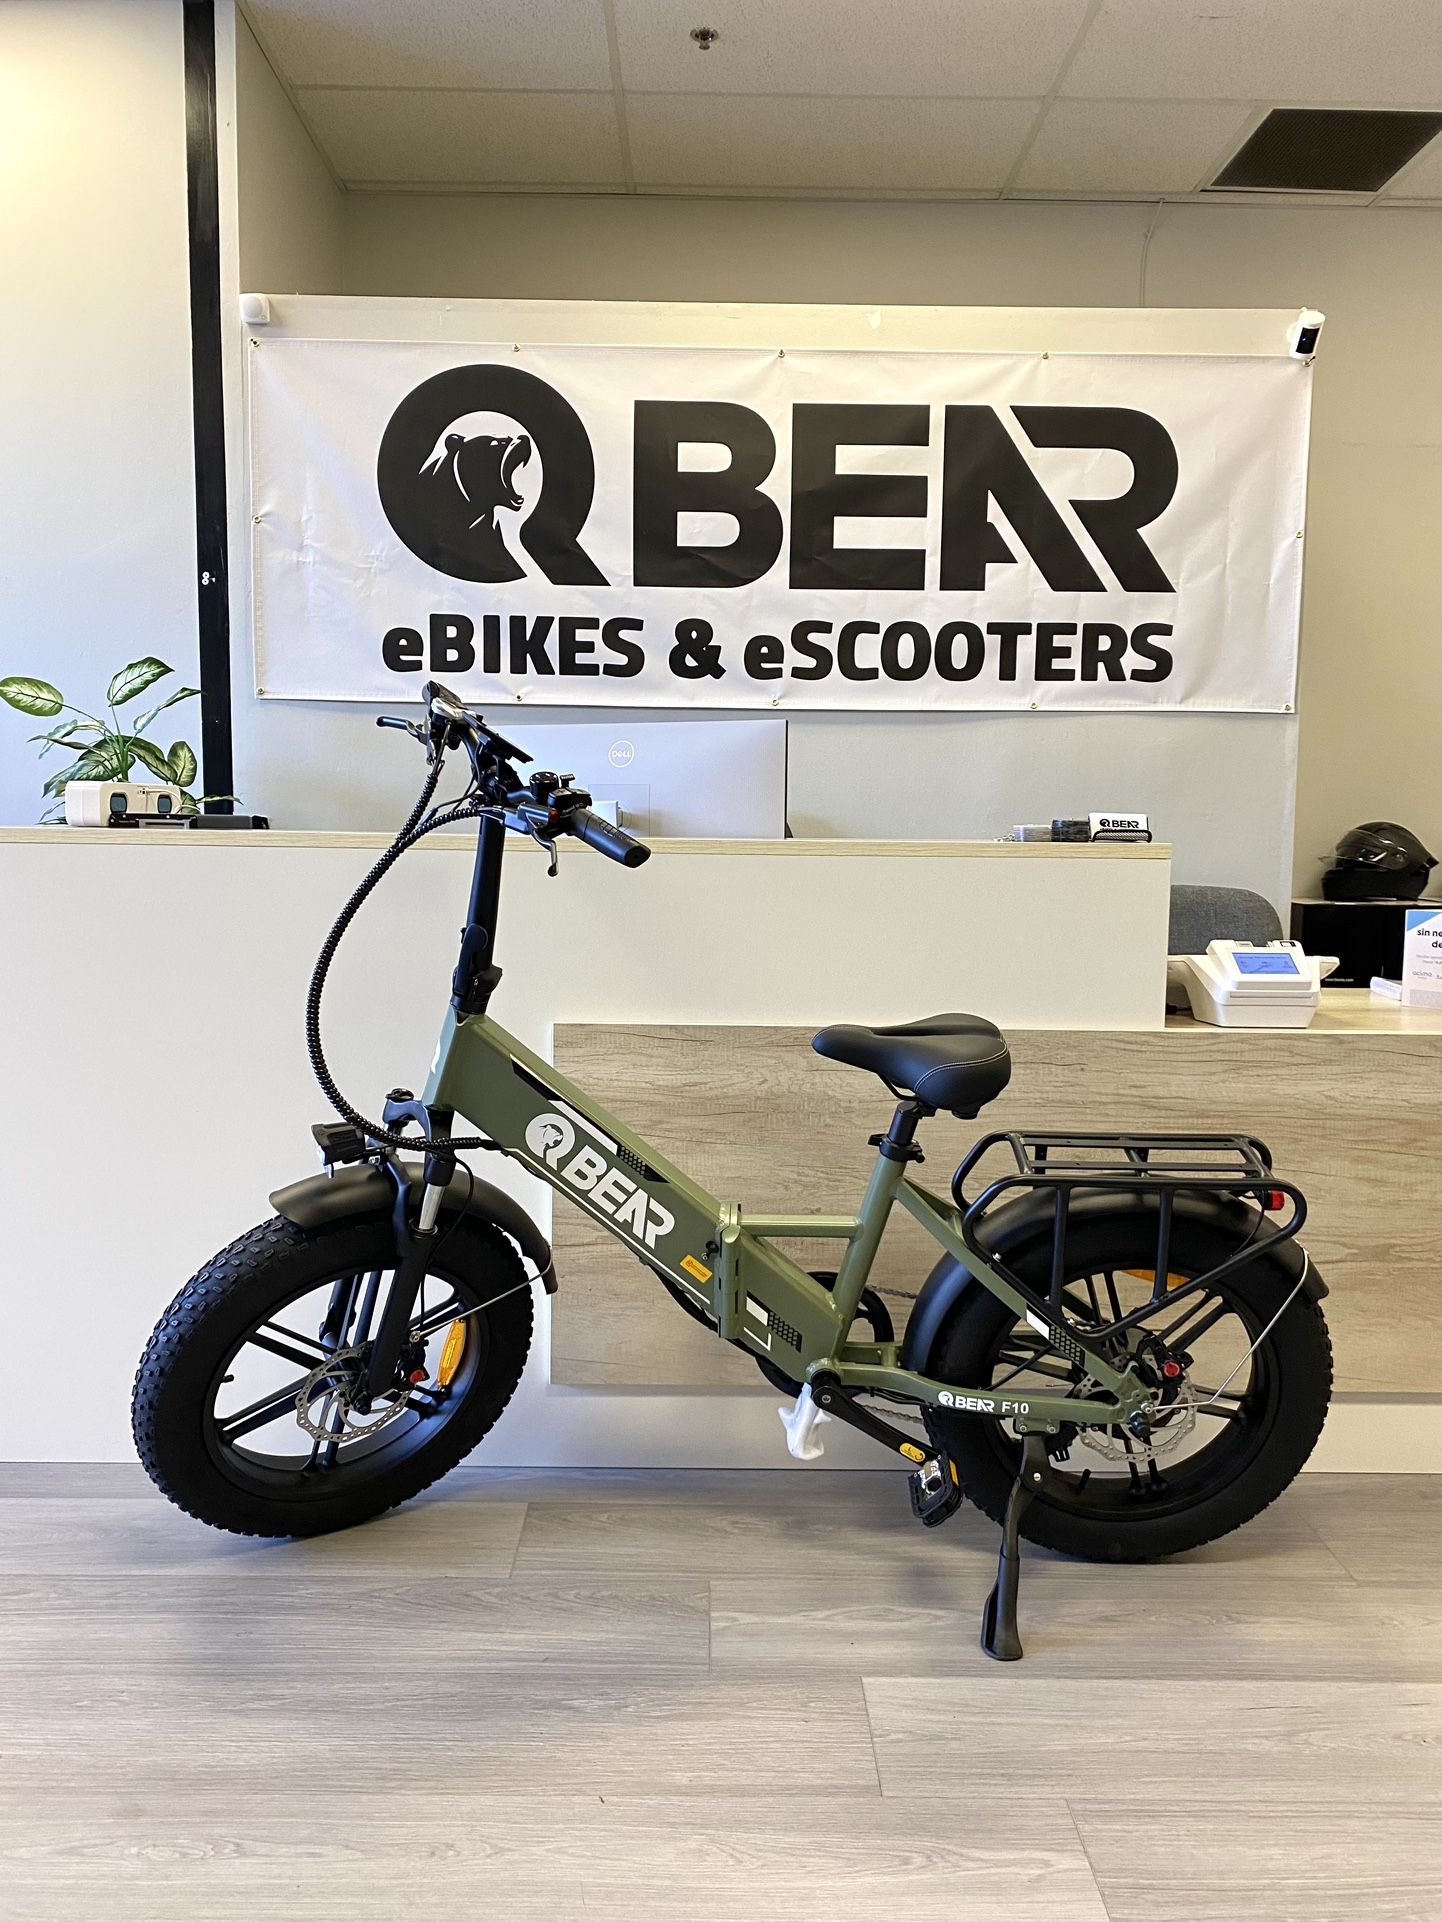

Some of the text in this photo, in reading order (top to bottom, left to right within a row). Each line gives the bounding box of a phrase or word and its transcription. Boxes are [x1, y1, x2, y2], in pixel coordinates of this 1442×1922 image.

[382, 613, 1174, 683] eBIKES & eSCOOTERS
[611, 750, 631, 758] DELL
[1417, 928, 1430, 936] sin
[1001, 1401, 1030, 1414] F10
